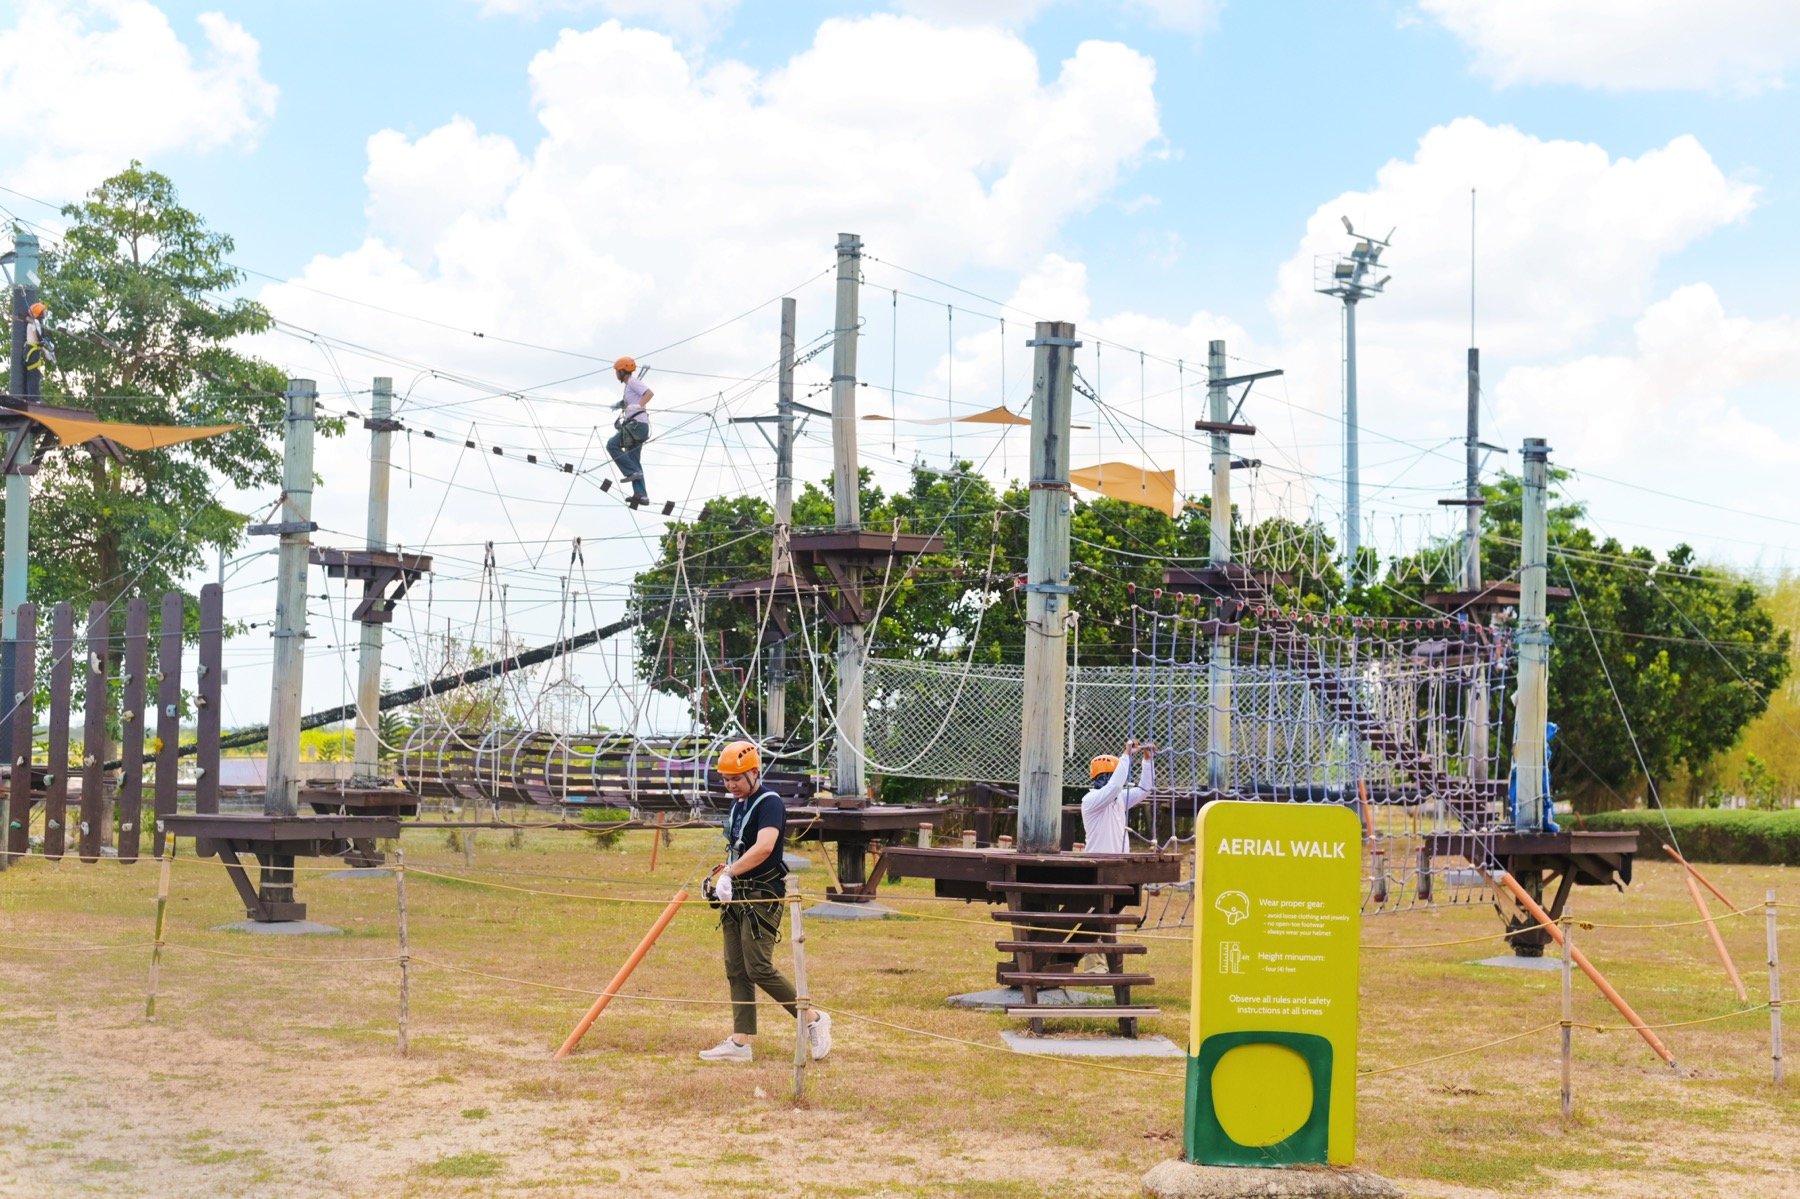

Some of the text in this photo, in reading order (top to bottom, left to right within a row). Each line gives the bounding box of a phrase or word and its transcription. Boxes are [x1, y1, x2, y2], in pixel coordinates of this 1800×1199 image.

[1217, 838, 1345, 859] AERIAL WALK
[1259, 898, 1279, 907] Wear
[1280, 900, 1305, 909] proper
[1298, 914, 1320, 922] clothing
[1331, 914, 1350, 922] jewelry
[1258, 952, 1283, 963] Height
[1228, 994, 1331, 1006] Observe all rules and safety
[1237, 1006, 1280, 1014] instructions
[1291, 1007, 1300, 1015] all
[1301, 1007, 1323, 1016] times
